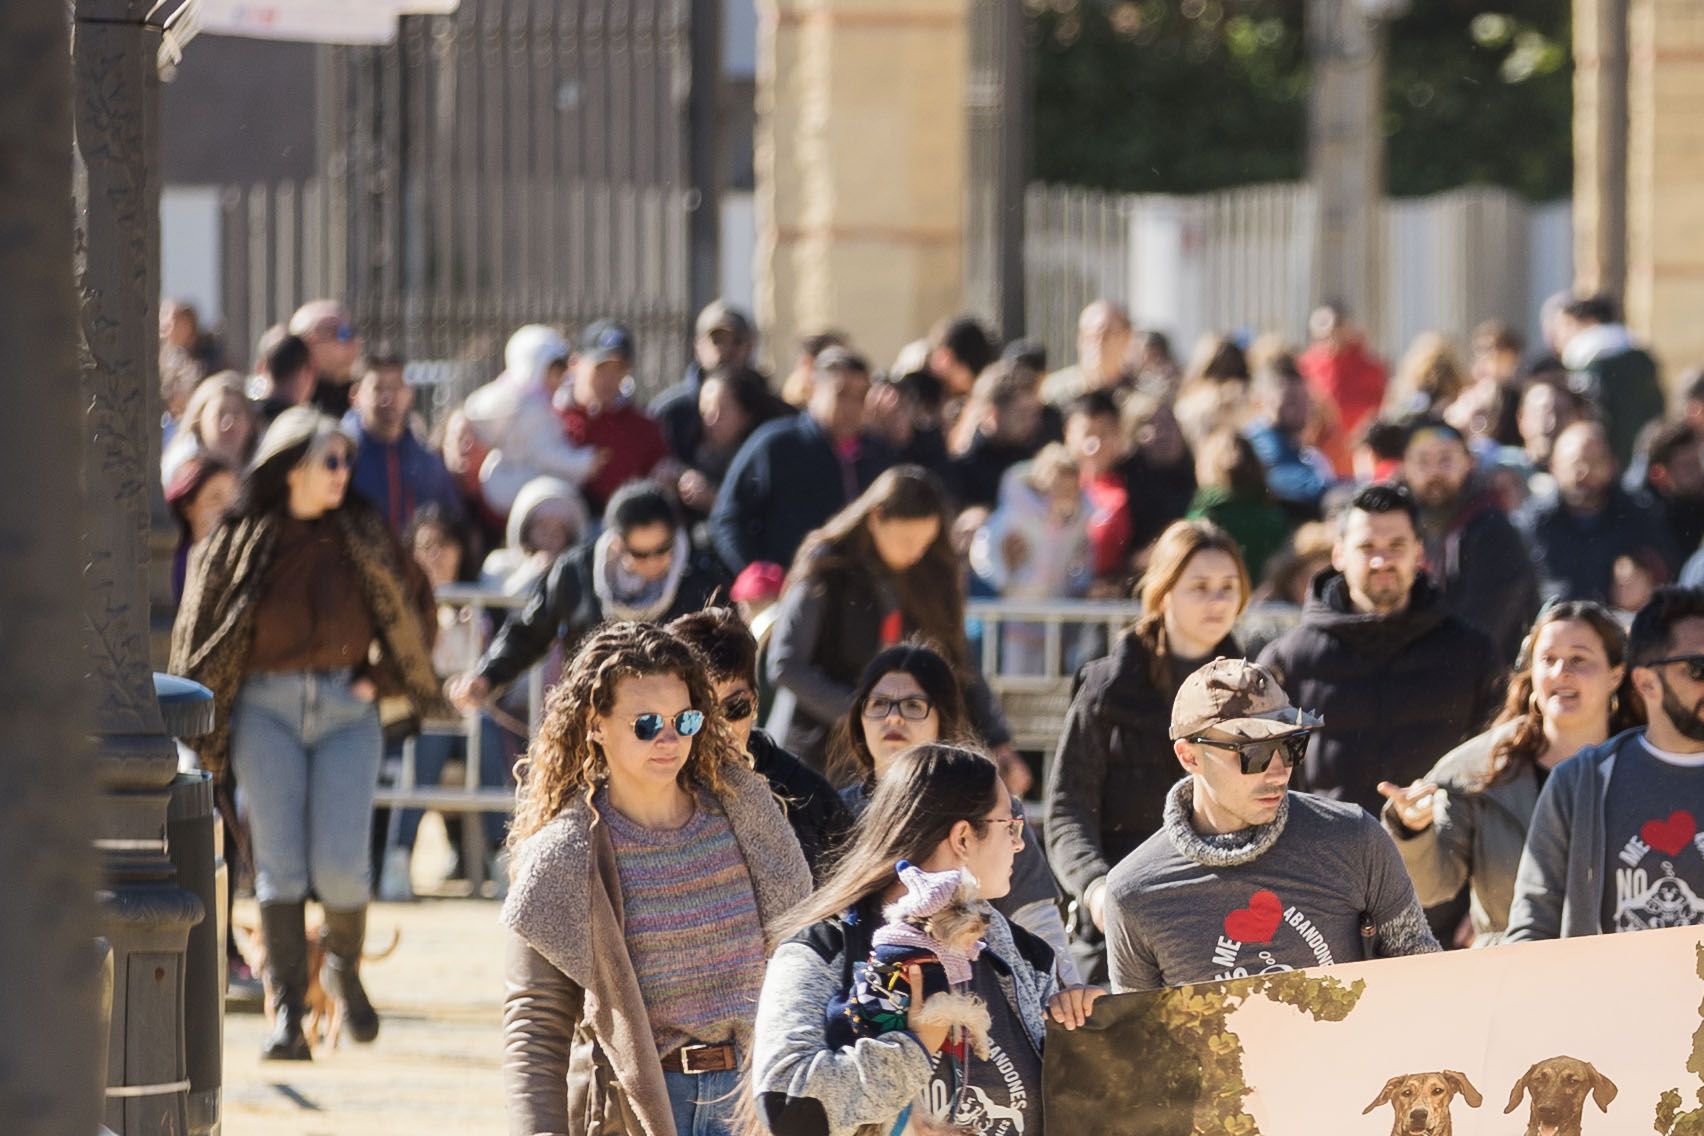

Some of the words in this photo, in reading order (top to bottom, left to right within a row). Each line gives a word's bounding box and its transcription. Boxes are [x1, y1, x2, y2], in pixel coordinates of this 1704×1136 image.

[1618, 834, 1651, 868] ME
[1616, 867, 1649, 906] NO
[1211, 935, 1242, 967] ME
[1284, 905, 1335, 966] ABANDON
[987, 1037, 1028, 1110] ANDONES
